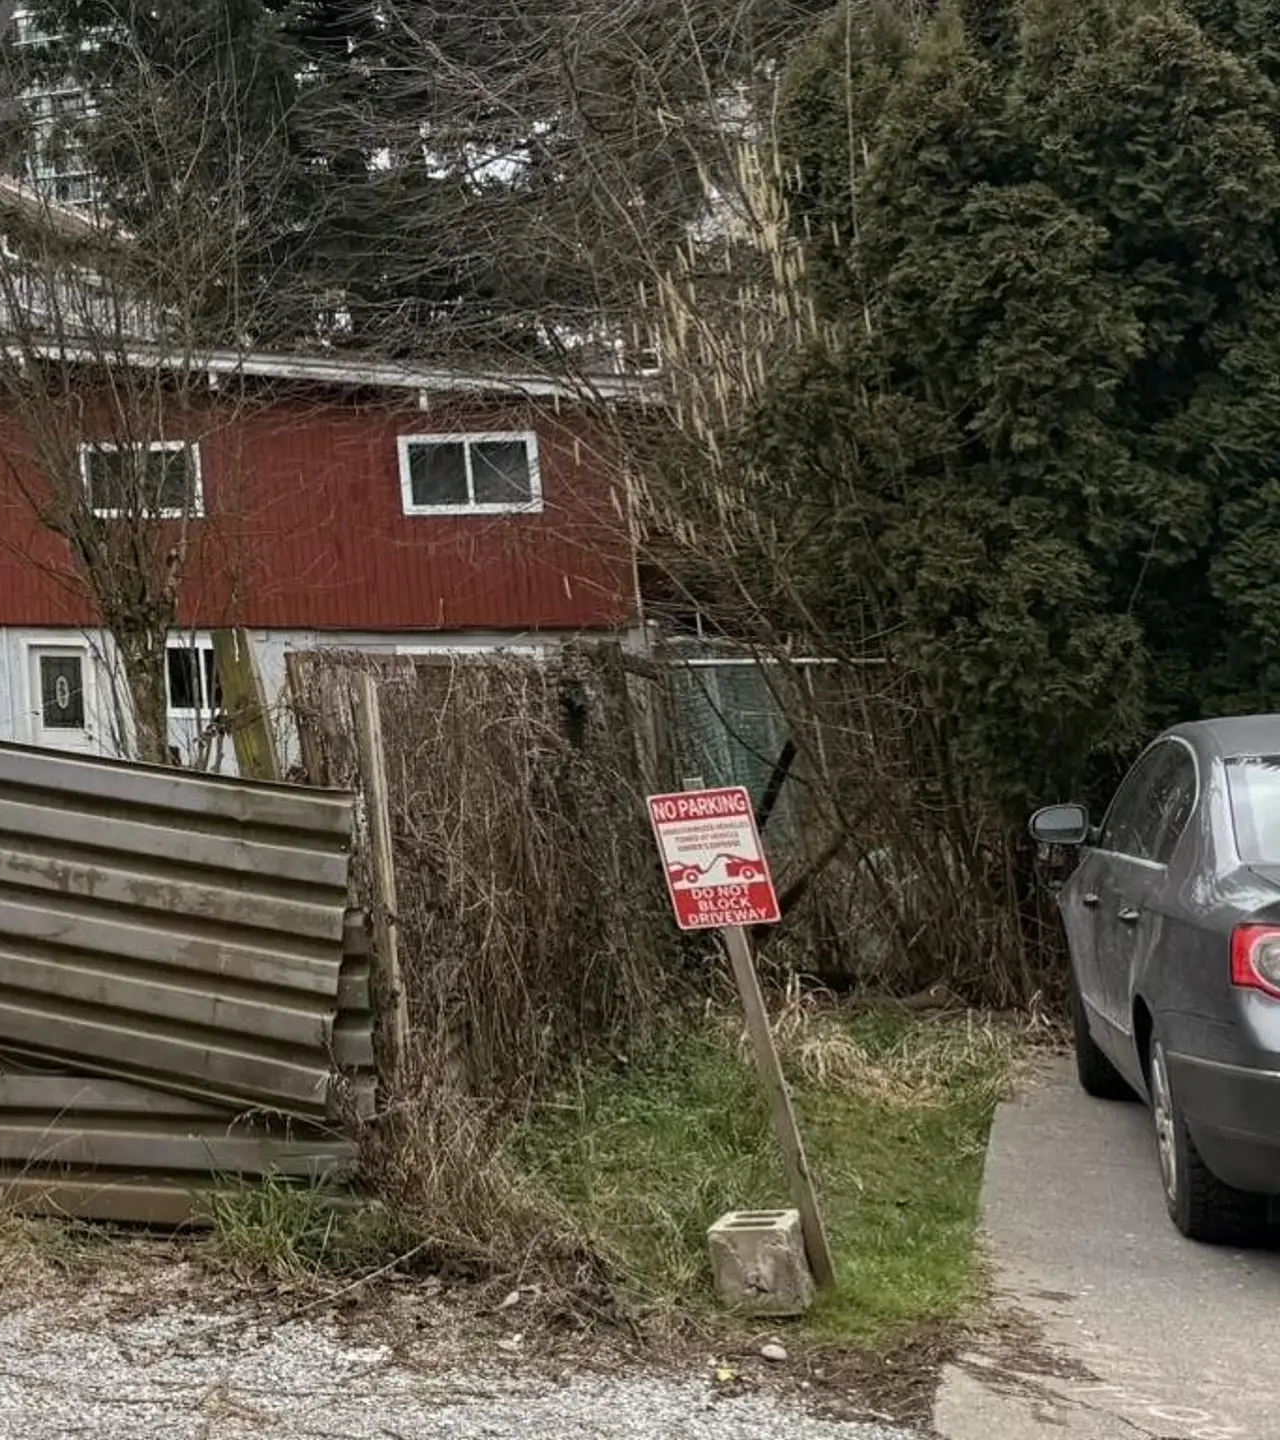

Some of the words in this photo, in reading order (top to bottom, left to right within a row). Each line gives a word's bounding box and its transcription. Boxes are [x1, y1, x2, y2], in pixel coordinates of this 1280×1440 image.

[651, 800, 676, 820] NO
[678, 793, 746, 818] PARKING
[690, 888, 715, 900] DO
[716, 885, 750, 898] NOT
[697, 898, 752, 911] BLOCK
[687, 907, 768, 926] DRIVEWAY
